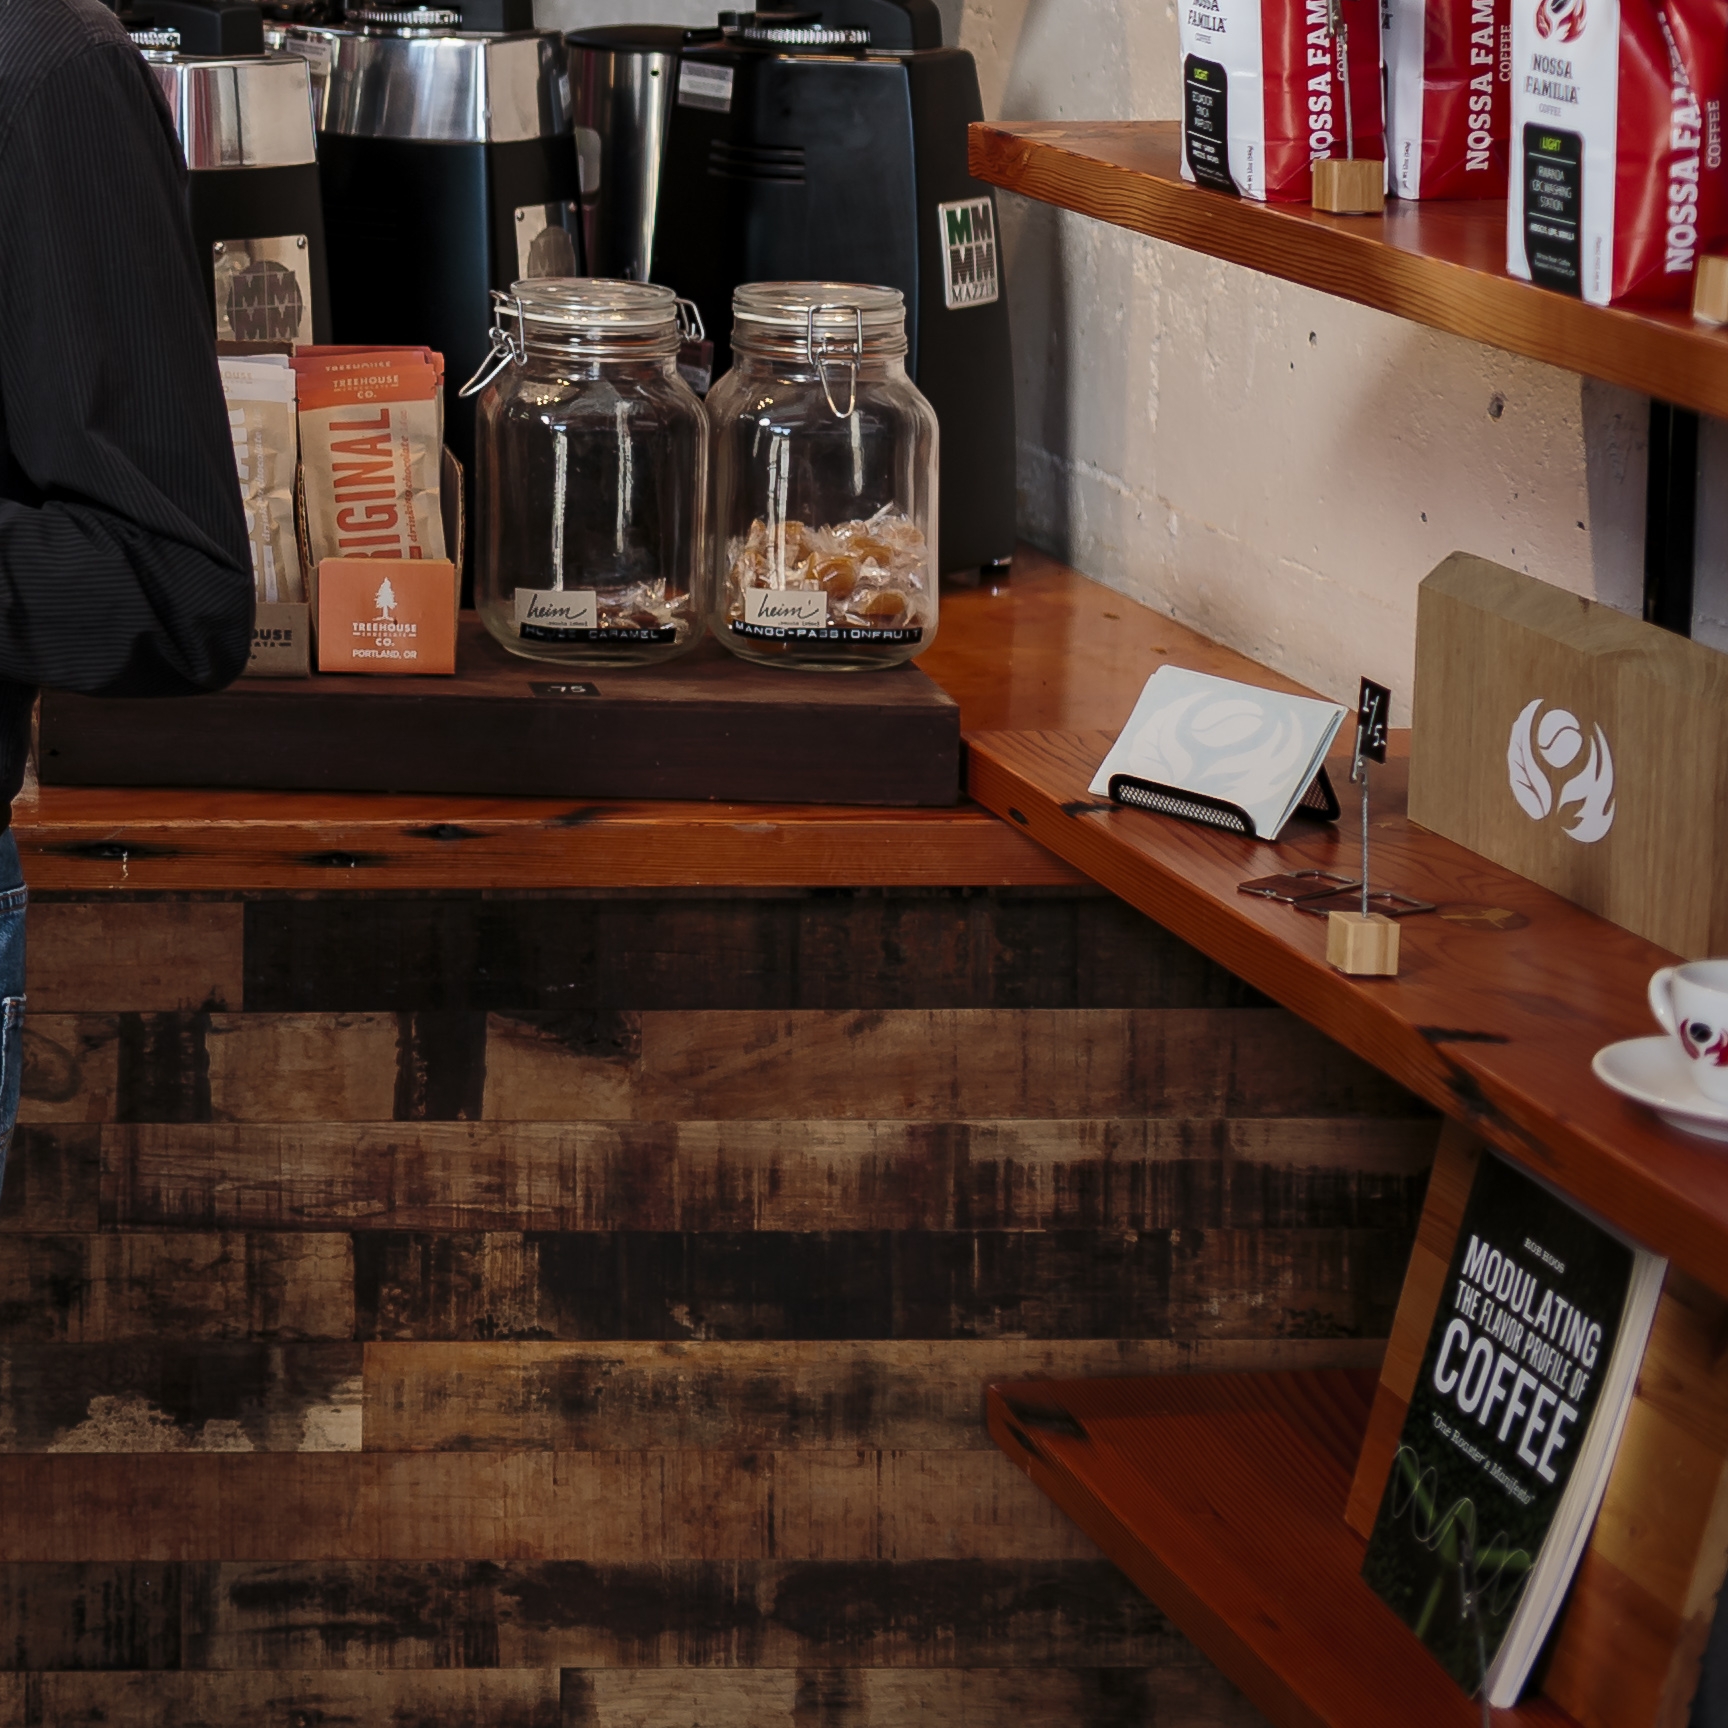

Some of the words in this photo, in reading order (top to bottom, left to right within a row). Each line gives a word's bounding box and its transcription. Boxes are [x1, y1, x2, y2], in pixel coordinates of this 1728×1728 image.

[1499, 24, 1513, 83] COFFEE
[1532, 53, 1573, 80] NOSSA
[1524, 75, 1580, 106] FAMILIA
[1465, 80, 1495, 171] NOSSA
[1706, 100, 1722, 170] COFFEE
[1665, 152, 1701, 275] NOSSA
[332, 375, 399, 389] TREEHOUSE
[356, 390, 377, 400] CO.
[526, 593, 588, 620] heim
[757, 594, 820, 620] heim
[352, 623, 417, 634] TREEHOUSE
[375, 637, 396, 647] CO.
[734, 619, 921, 641] MANGO-PASSIONFRUIT
[352, 648, 402, 660] PORTLAND,
[404, 649, 417, 659] OR
[1461, 1234, 1602, 1369] MODULATING
[1454, 1279, 1482, 1321] THE
[1478, 1298, 1525, 1354] FLAVOR
[1521, 1331, 1573, 1392] PROFILE
[1568, 1369, 1590, 1403] OF
[1433, 1317, 1579, 1484] COFFEE
